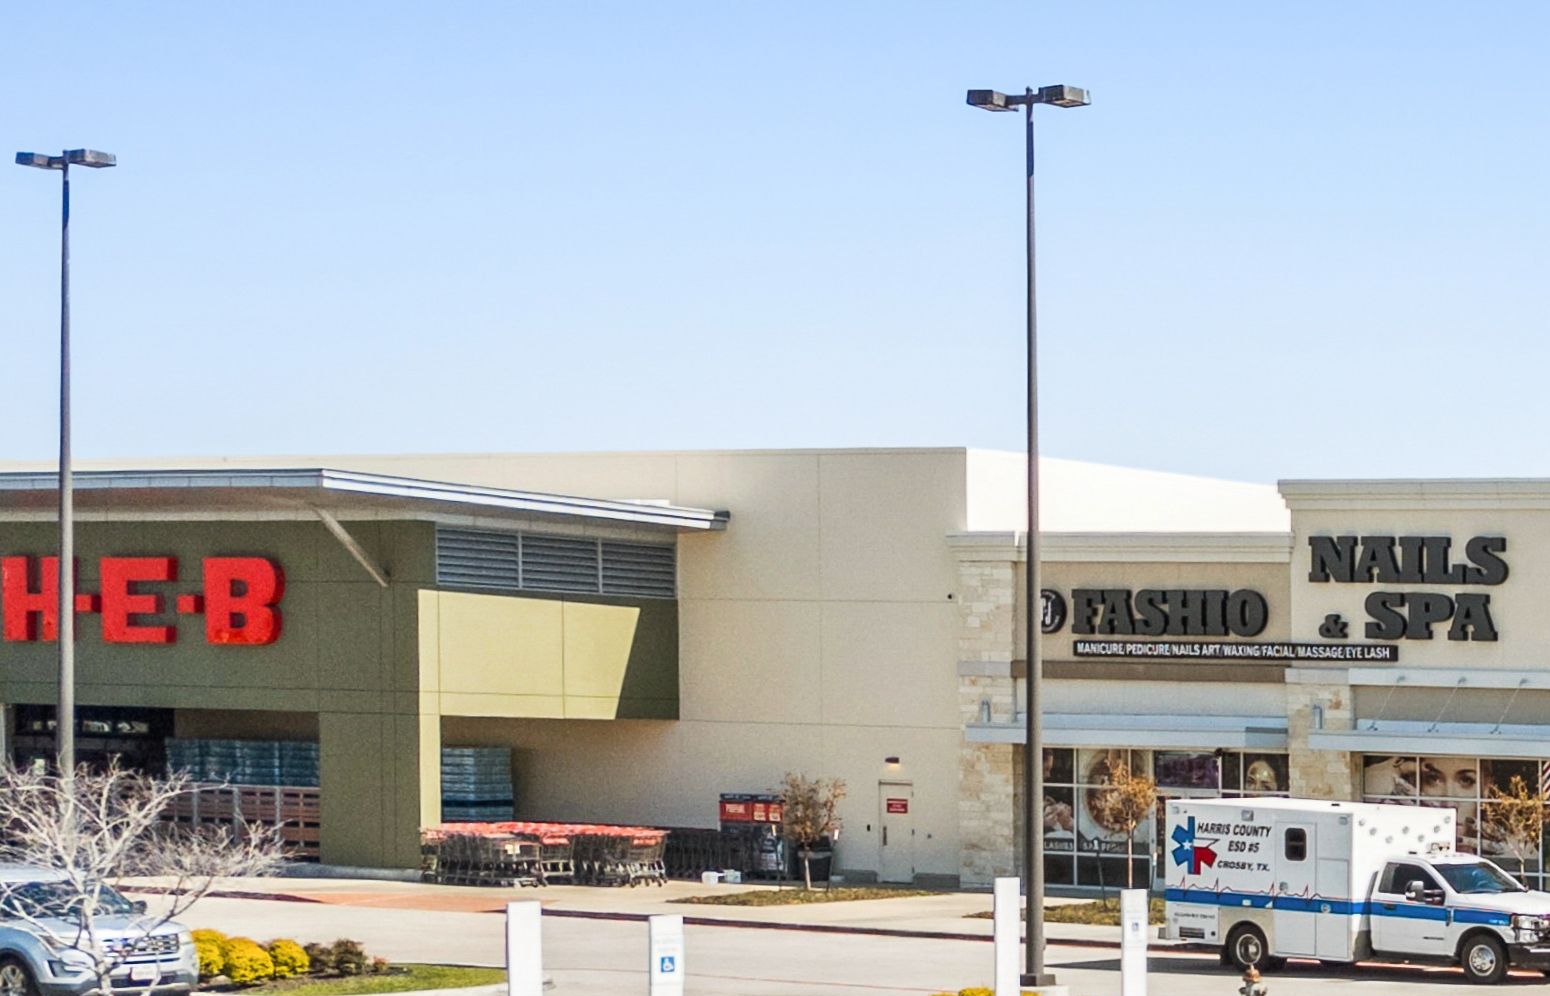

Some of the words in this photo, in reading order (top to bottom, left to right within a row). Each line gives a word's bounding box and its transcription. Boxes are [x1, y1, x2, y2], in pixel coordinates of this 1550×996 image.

[1308, 535, 1510, 585] NAILS
[1071, 588, 1269, 637] FASHIO
[1318, 614, 1349, 639] &
[1365, 591, 1499, 641] SPA
[1197, 822, 1231, 835] HARRIS
[1233, 825, 1272, 837] COUNTY
[1228, 840, 1246, 852] ESD
[1248, 842, 1260, 853] #5
